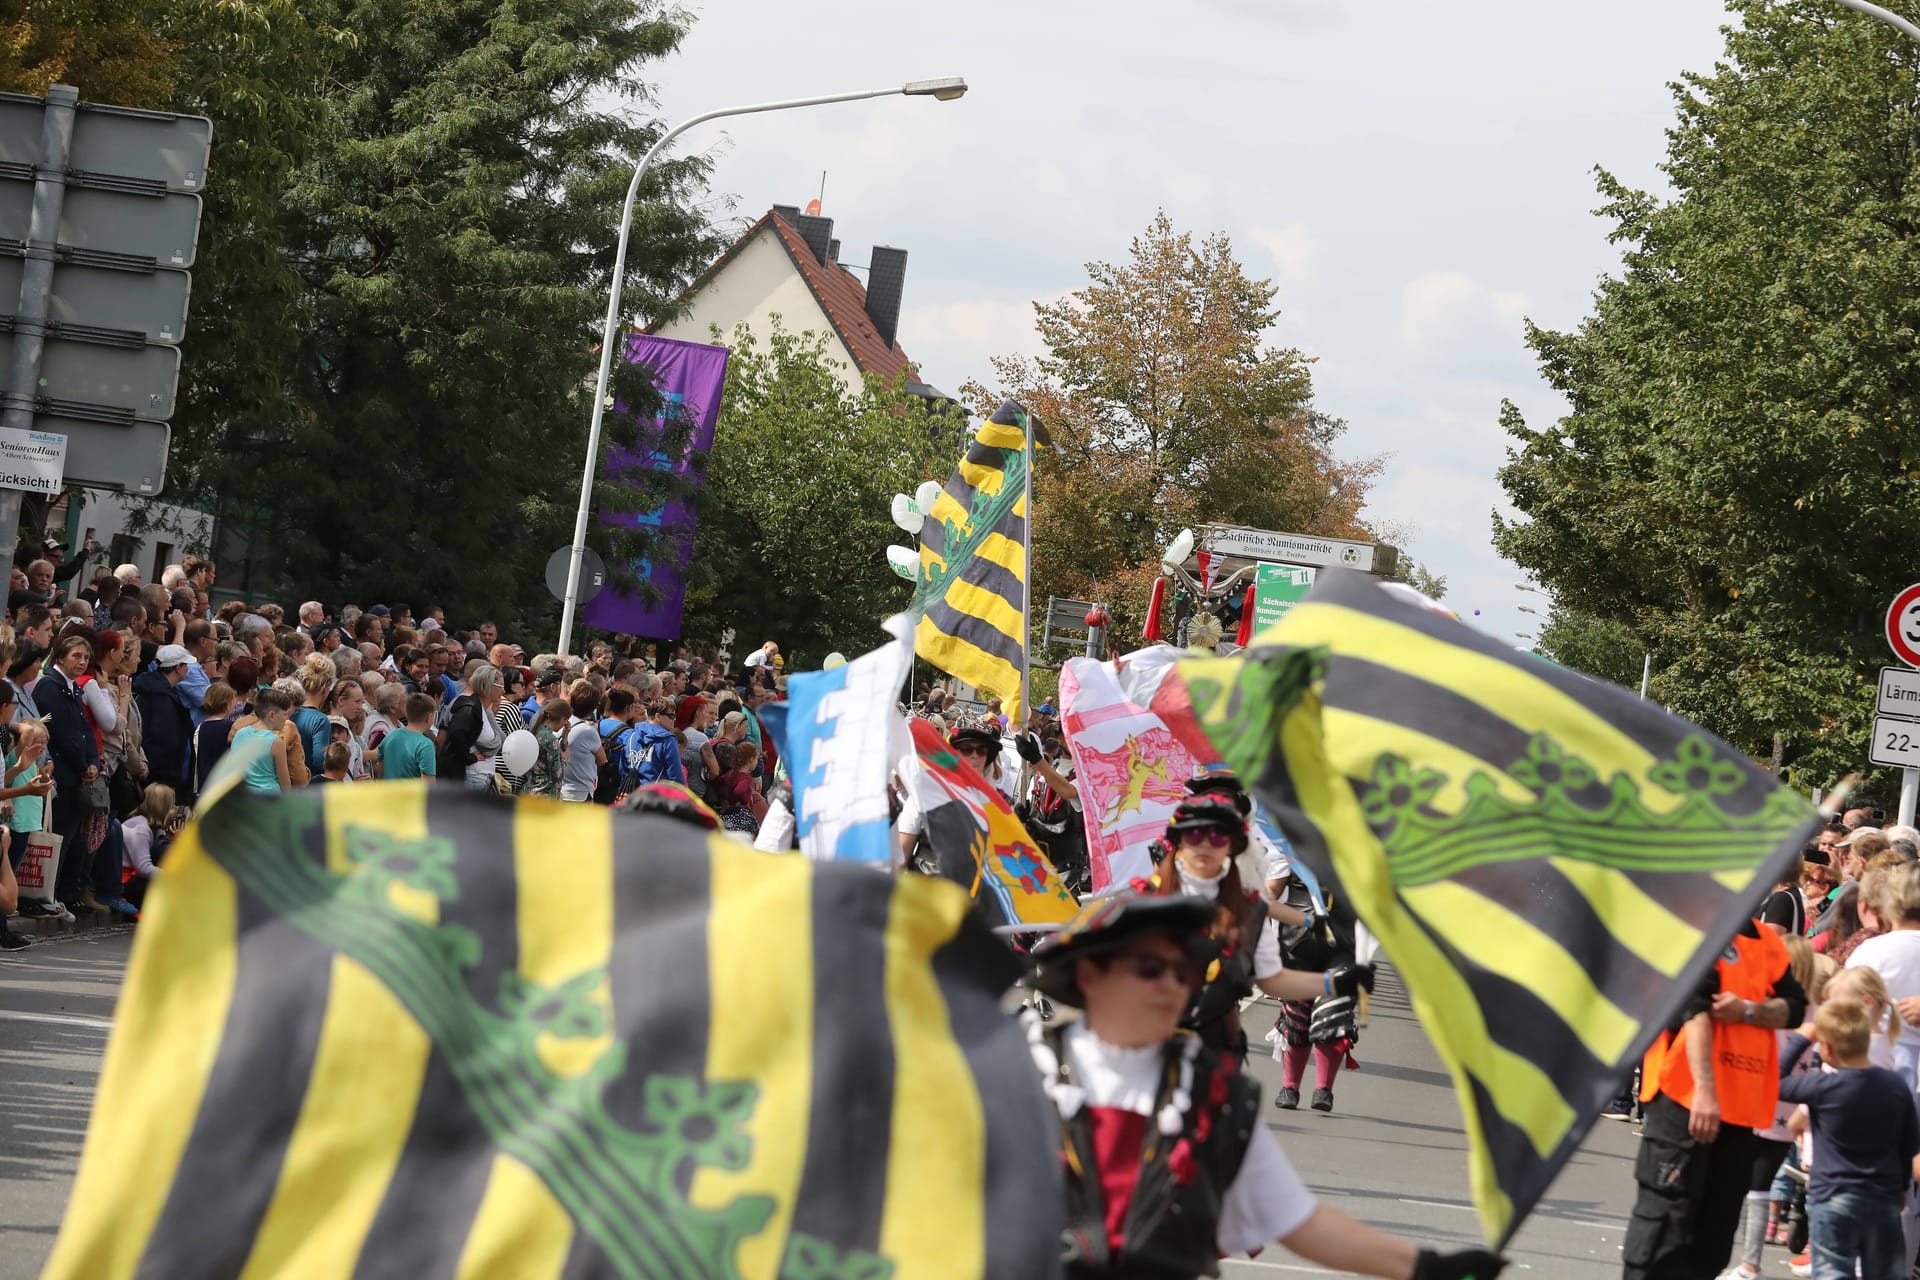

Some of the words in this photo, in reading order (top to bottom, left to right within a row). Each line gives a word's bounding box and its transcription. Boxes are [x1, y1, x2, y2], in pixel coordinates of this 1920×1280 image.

[0, 441, 60, 457] SeniorenHaus
[1299, 570, 1309, 583] 11
[1886, 684, 1920, 702] Lärm
